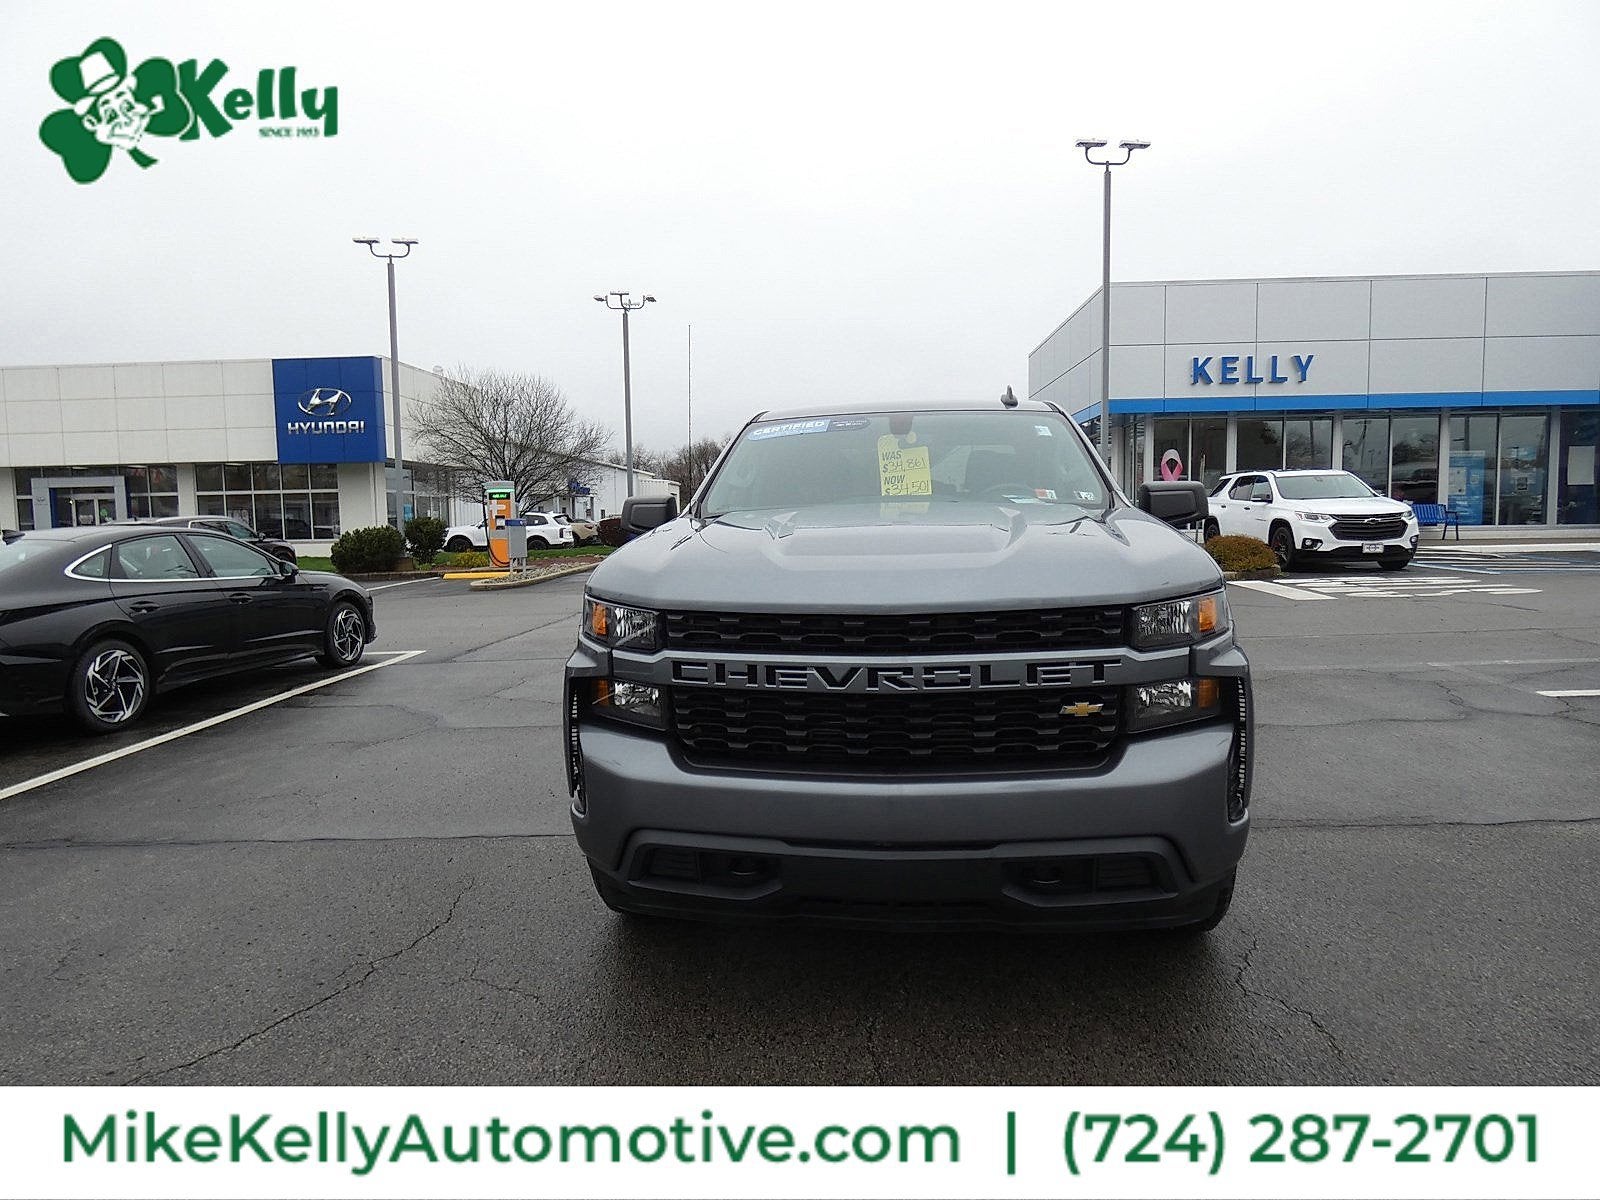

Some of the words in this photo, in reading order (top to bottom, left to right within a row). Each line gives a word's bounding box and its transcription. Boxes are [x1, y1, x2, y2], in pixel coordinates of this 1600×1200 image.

[1191, 354, 1314, 385] KELLY
[288, 421, 366, 435] HYUNDAI
[752, 420, 826, 435] CERTIFIED
[882, 450, 903, 461] WAS
[884, 474, 905, 485] NOW
[671, 660, 1121, 691] CHEVROLET
